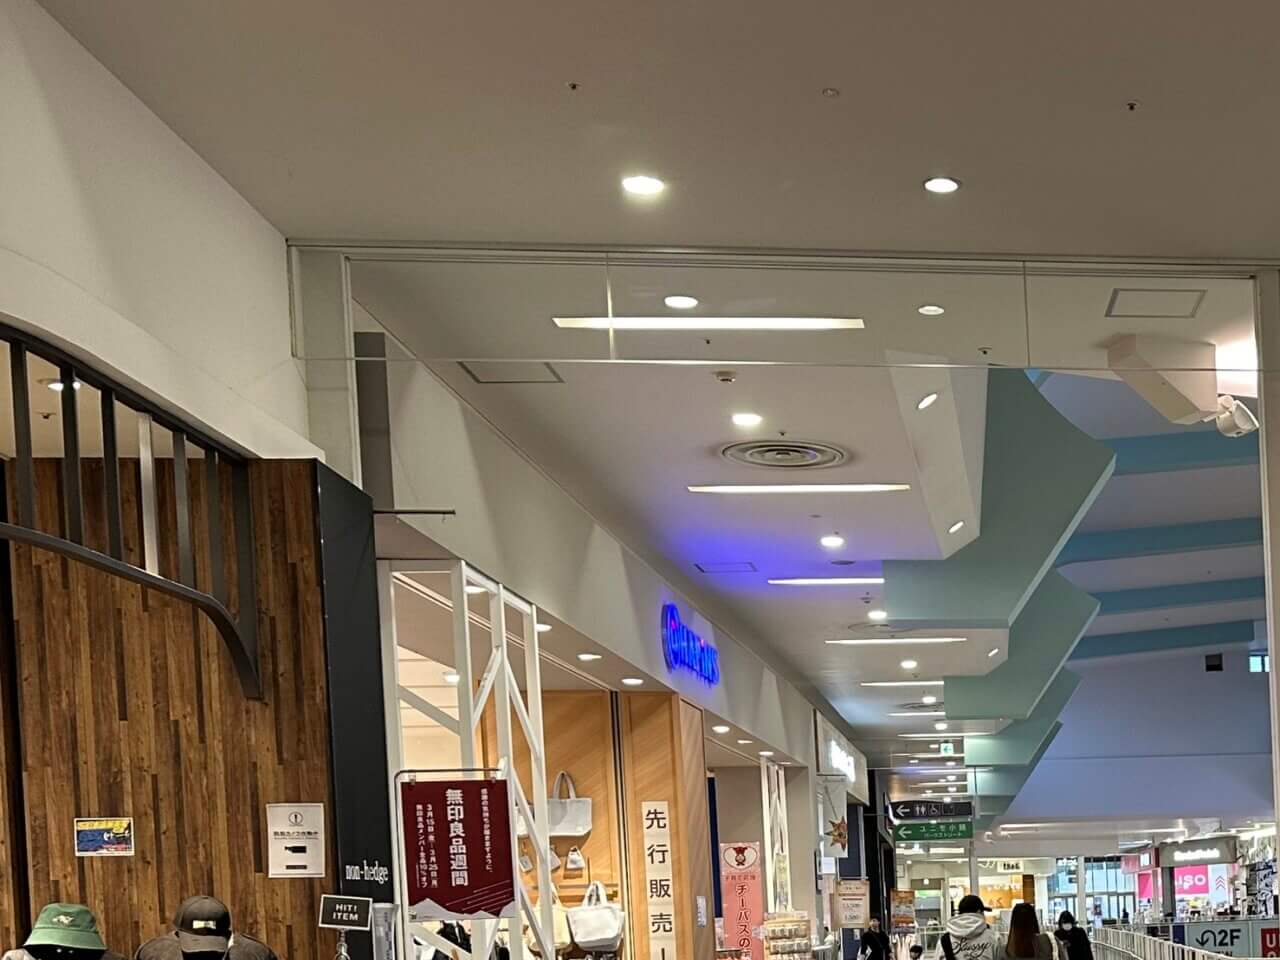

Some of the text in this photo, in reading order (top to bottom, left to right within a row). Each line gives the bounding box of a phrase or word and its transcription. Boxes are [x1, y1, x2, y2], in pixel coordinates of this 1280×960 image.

[445, 788, 469, 887] 無印良品週間
[345, 860, 389, 884] non-hedge
[332, 912, 359, 921] ITEM
[335, 903, 358, 912] HIT!
[1217, 928, 1241, 947] 2F
